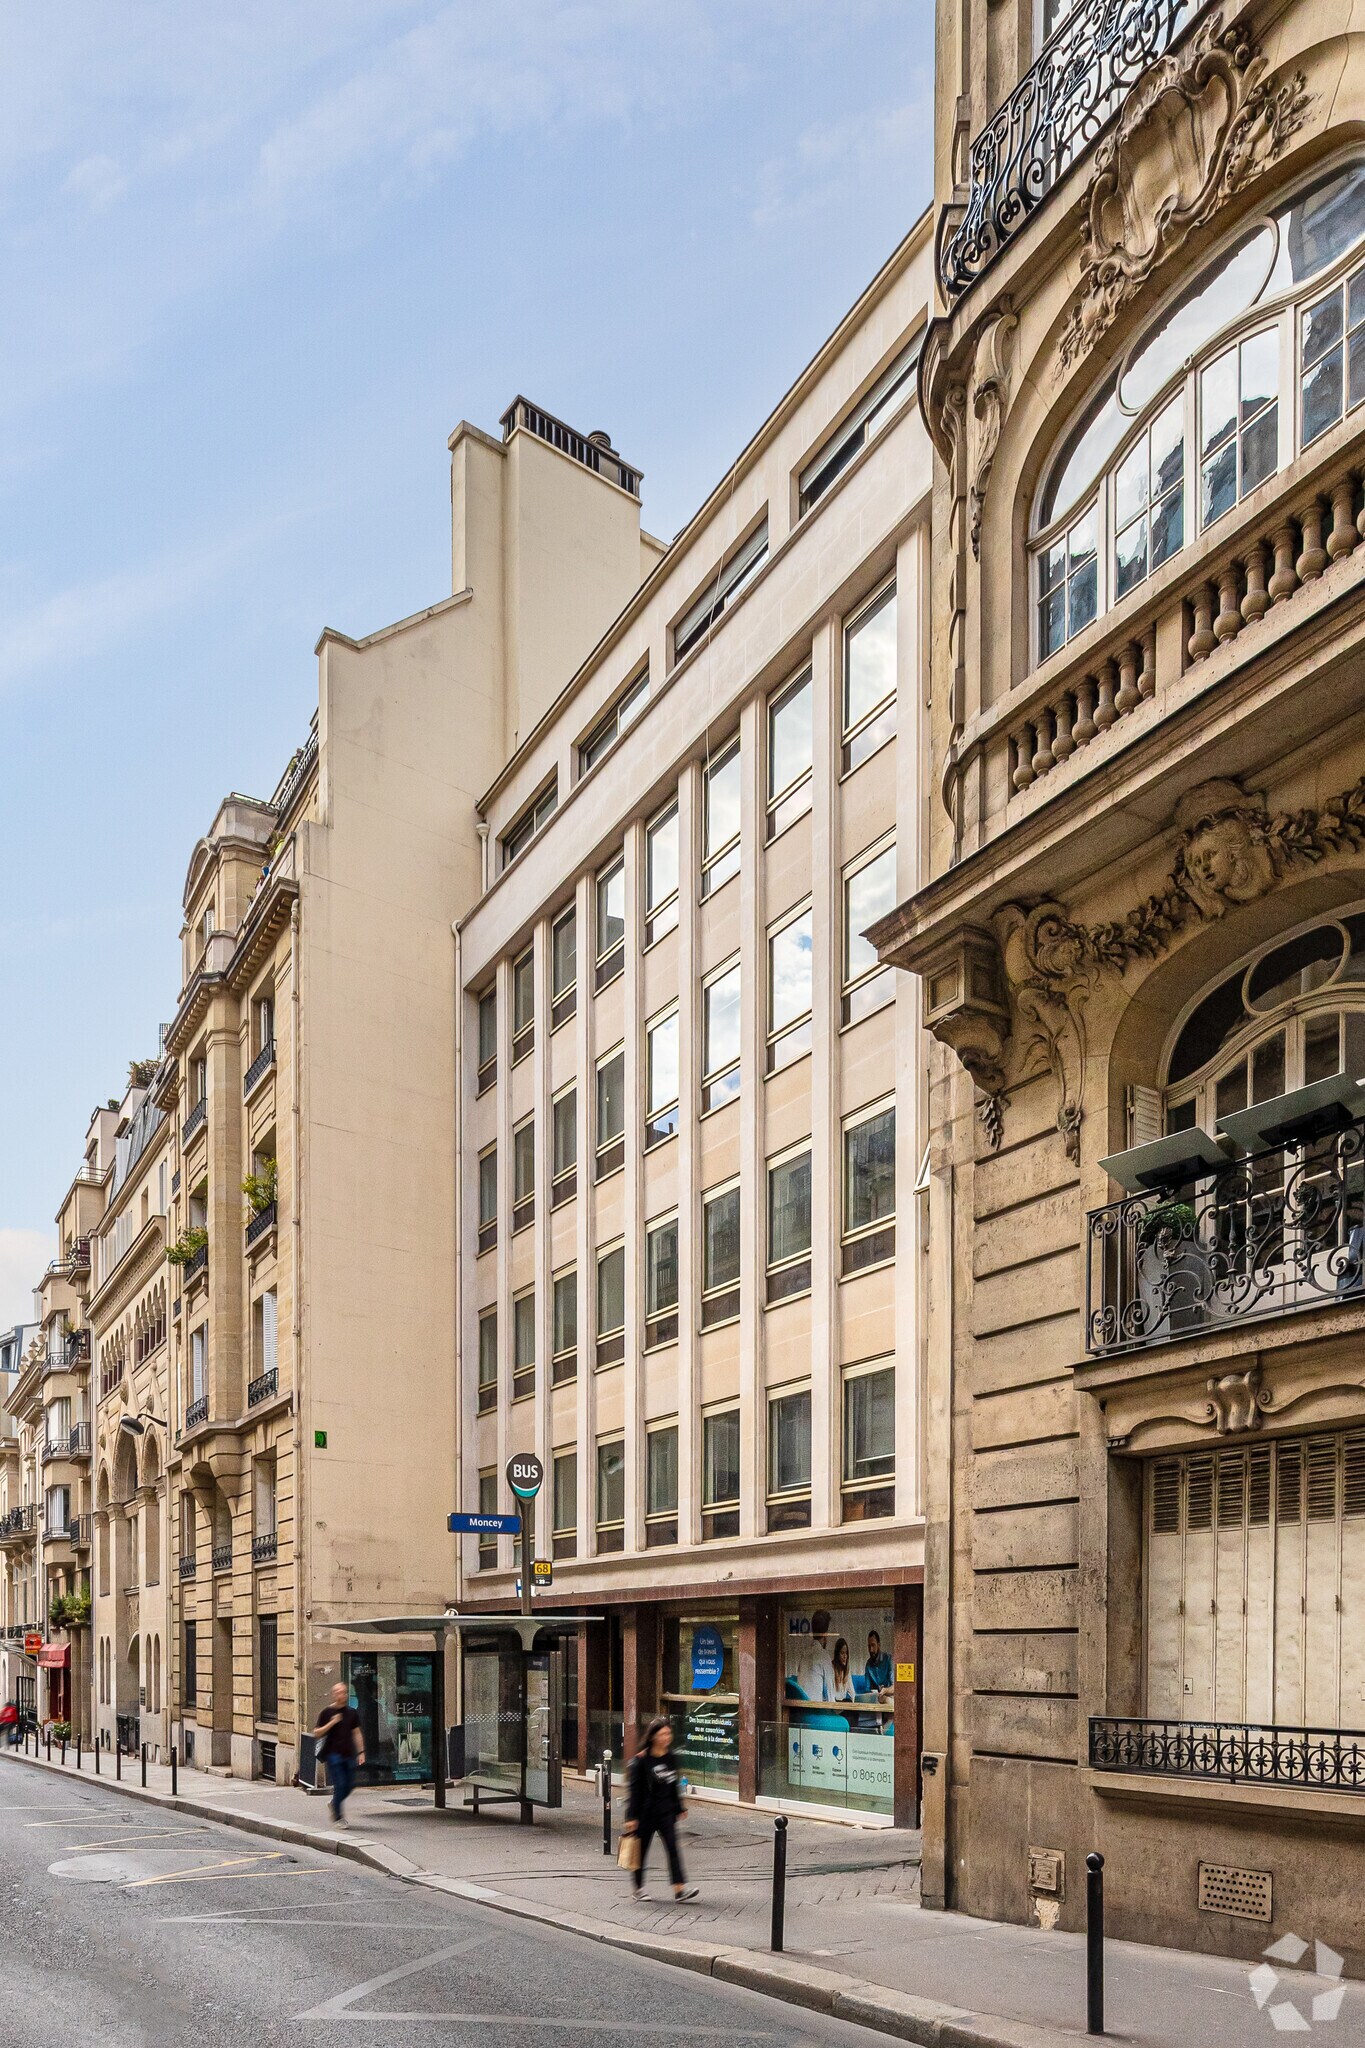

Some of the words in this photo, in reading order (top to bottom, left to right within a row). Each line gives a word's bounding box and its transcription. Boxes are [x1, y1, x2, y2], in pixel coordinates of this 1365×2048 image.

[513, 1464, 539, 1479] BUS
[469, 1518, 503, 1529] Moncey
[536, 1564, 549, 1573] 68
[395, 1702, 424, 1714] H24
[853, 1770, 858, 1780] 0
[860, 1768, 875, 1784] 805
[877, 1771, 892, 1784] 081
